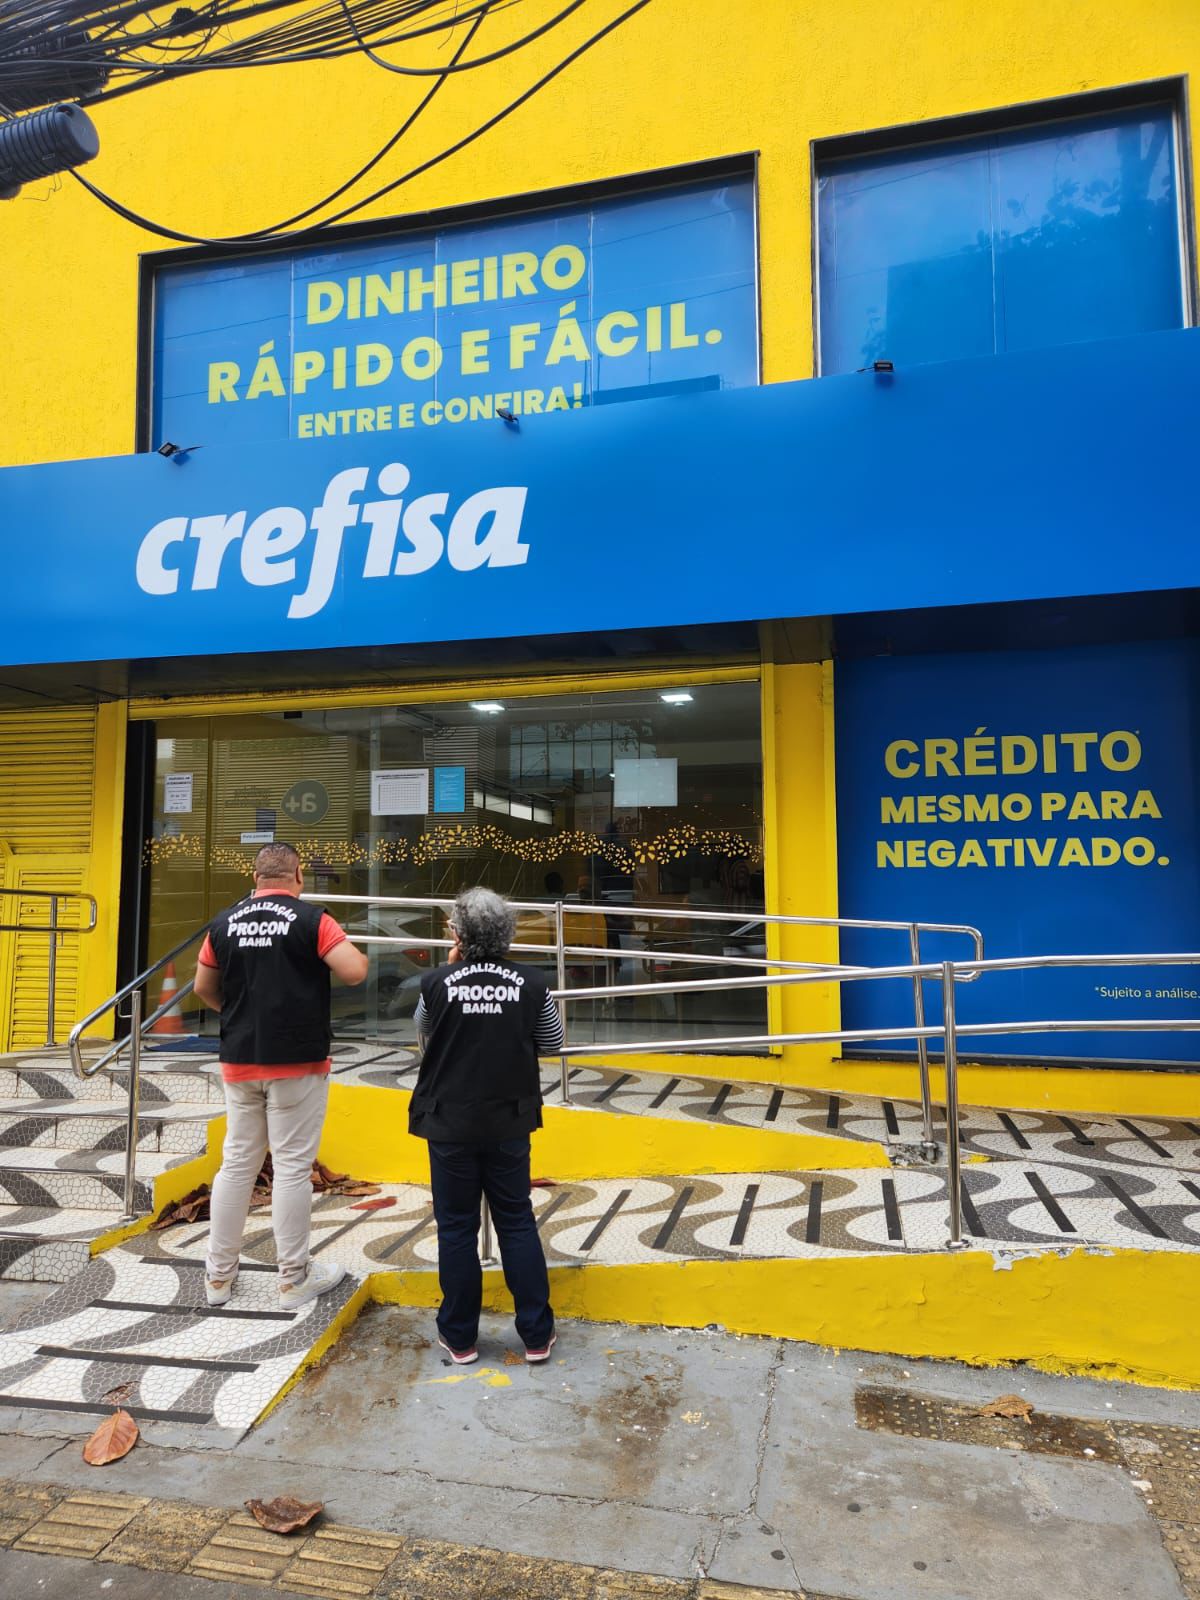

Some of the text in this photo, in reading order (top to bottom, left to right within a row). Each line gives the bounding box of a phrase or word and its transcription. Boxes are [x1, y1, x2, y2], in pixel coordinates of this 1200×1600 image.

[306, 245, 586, 325] DINHEIRO
[208, 300, 723, 404] RÁPIDO E FÁCIL.
[298, 383, 583, 438] ENTRE E CONFIRA!
[136, 463, 530, 619] crefisa
[881, 790, 1163, 824] MESMO PARA
[876, 836, 1170, 868] NEGATIVADO.
[228, 902, 297, 923] FISCALIZAÇÃO
[227, 921, 290, 937] PROCON
[239, 937, 272, 948] BAHIA
[443, 963, 525, 986] FISCALIZAÇÃO
[447, 985, 520, 1002] PROCON
[1145, 989, 1152, 998] a
[462, 1003, 503, 1014] BAHIA
